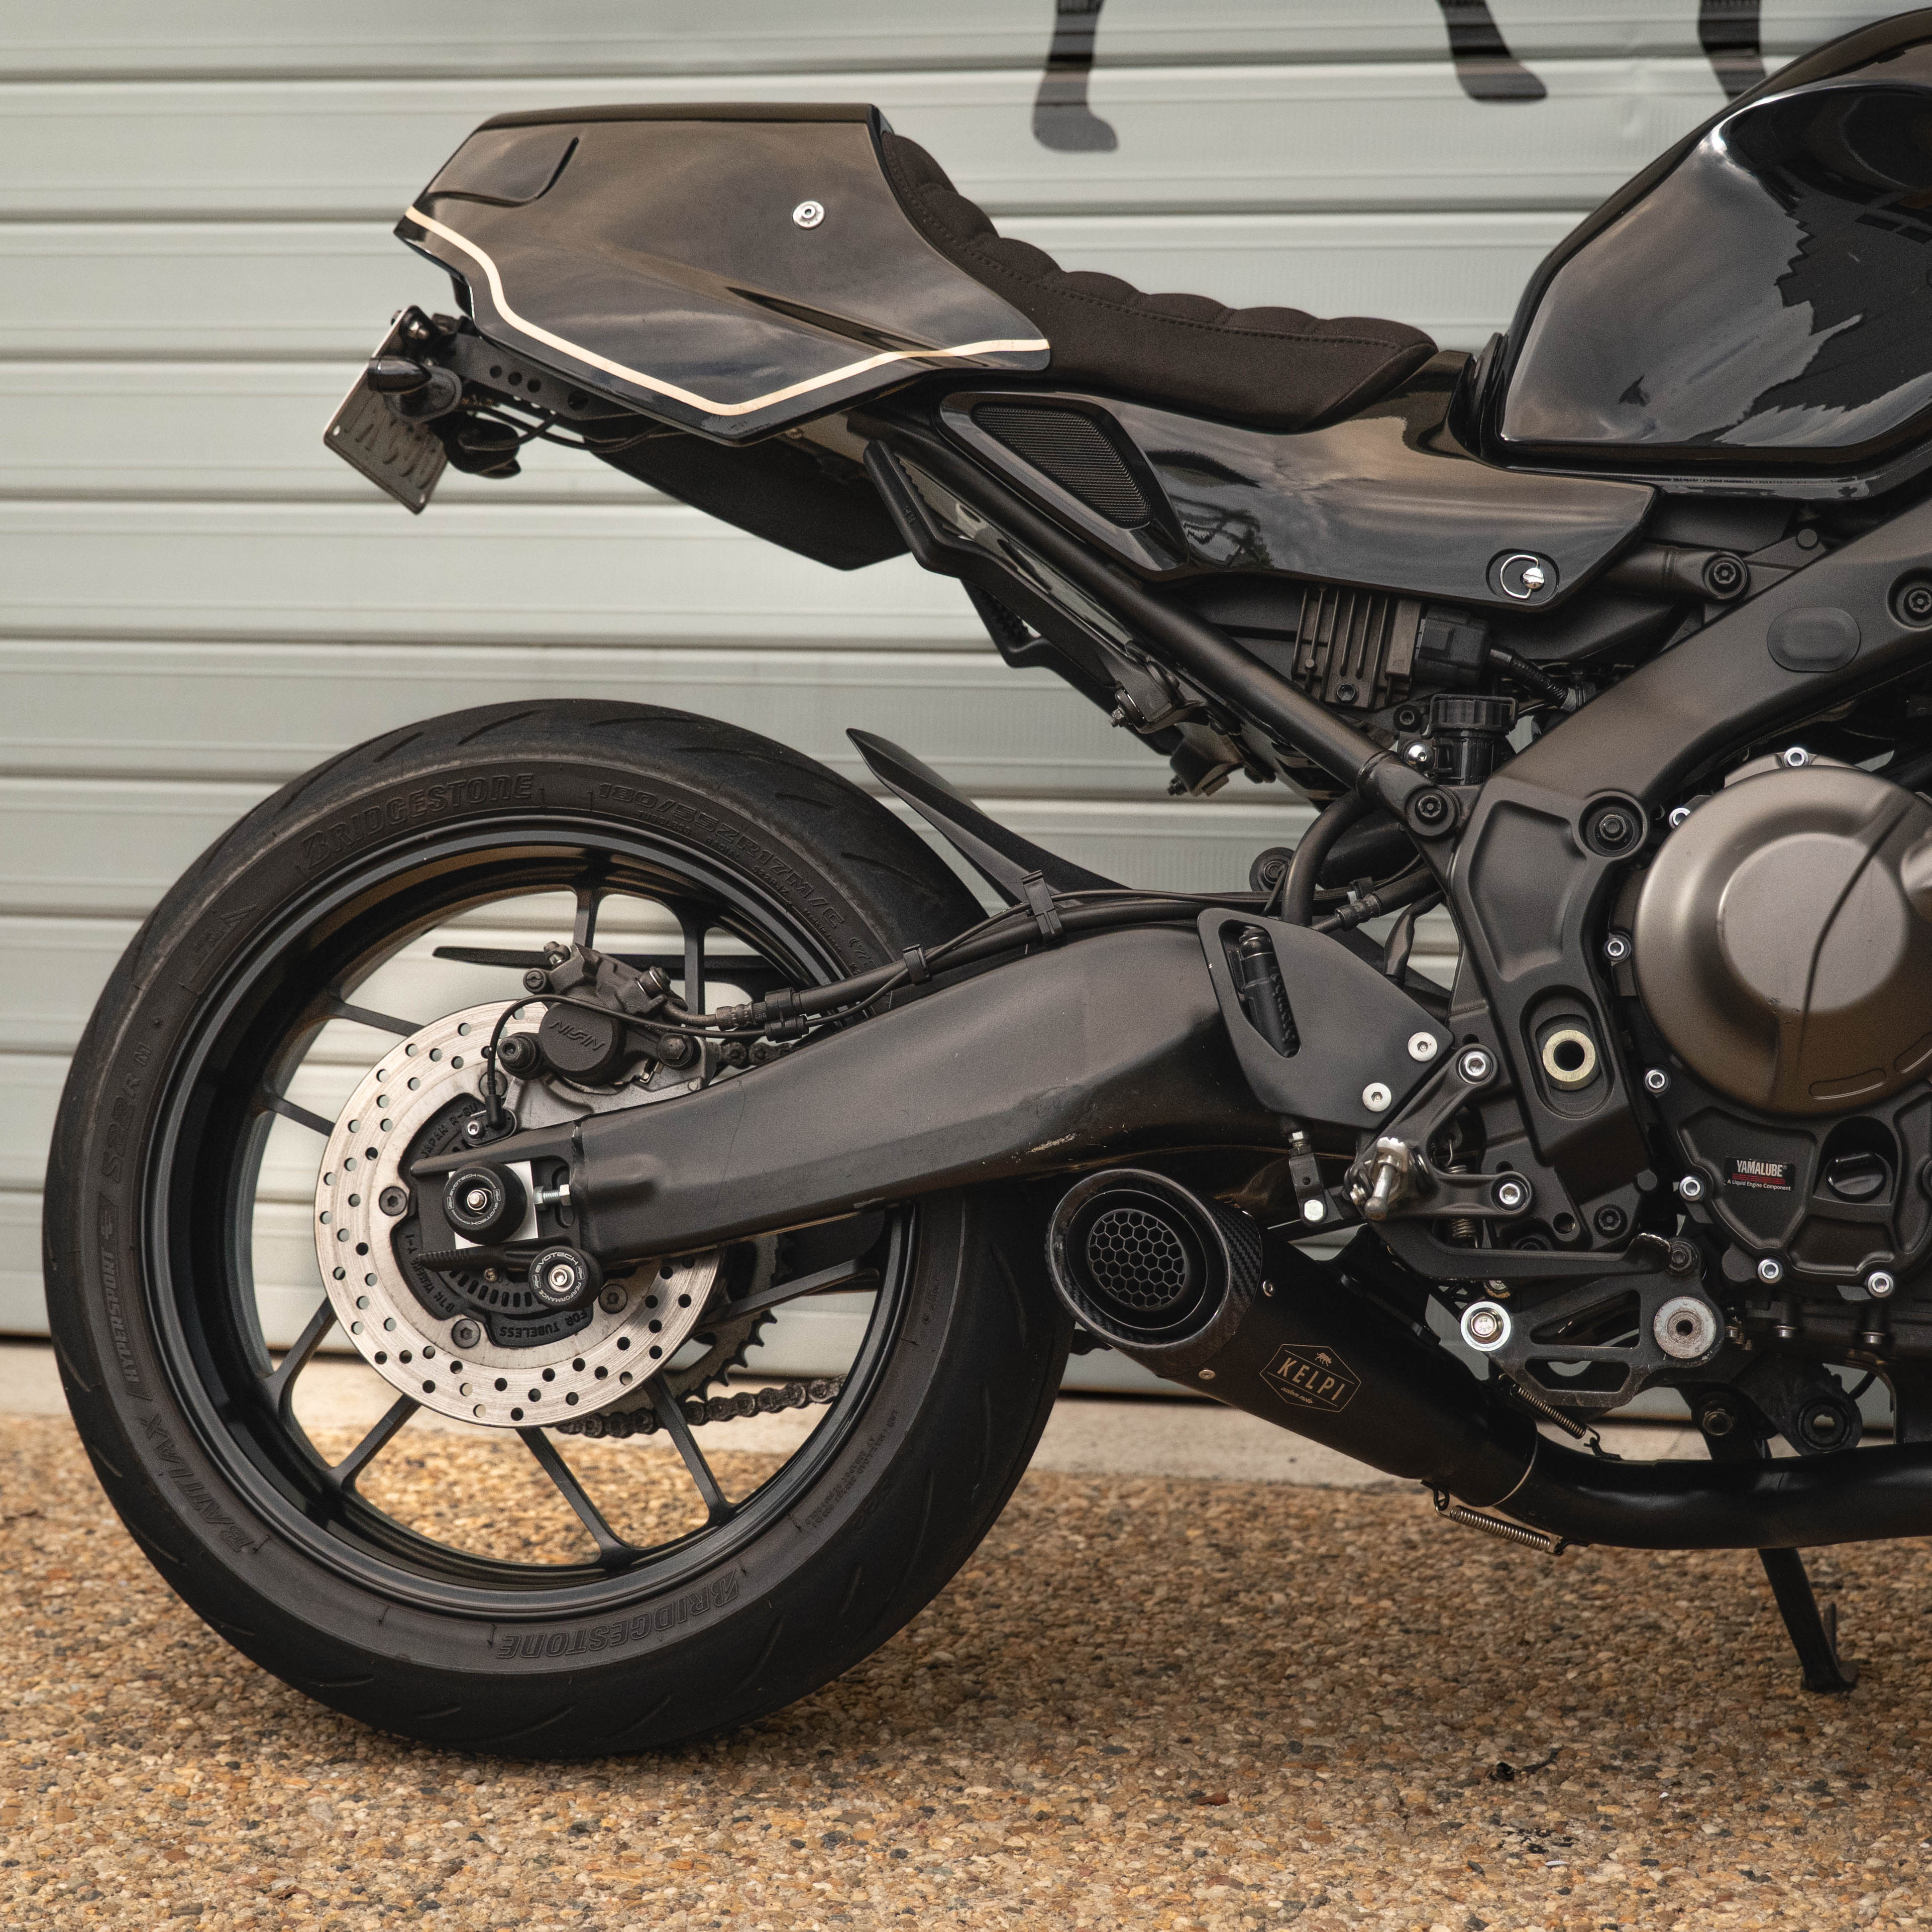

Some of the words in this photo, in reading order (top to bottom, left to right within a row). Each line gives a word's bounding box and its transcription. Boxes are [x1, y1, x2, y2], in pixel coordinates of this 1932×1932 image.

[300, 773, 532, 868] BRIDGESTONE
[549, 1020, 606, 1051] NISSIN
[1737, 1160, 1783, 1177] YAMALUBE
[450, 1173, 477, 1196] EVOTECH
[471, 1202, 498, 1226] EVOTECH
[535, 1252, 579, 1273] EVOTECH
[539, 1281, 582, 1303] PERFORMANCE
[102, 1250, 141, 1384] HYPERSPORT
[564, 1309, 588, 1327] FOR
[499, 1321, 560, 1338] TUBELESS
[1277, 1357, 1345, 1400] KELPI
[139, 1412, 247, 1553] BATTLAX
[498, 1570, 739, 1658] BRIDGESTONE
